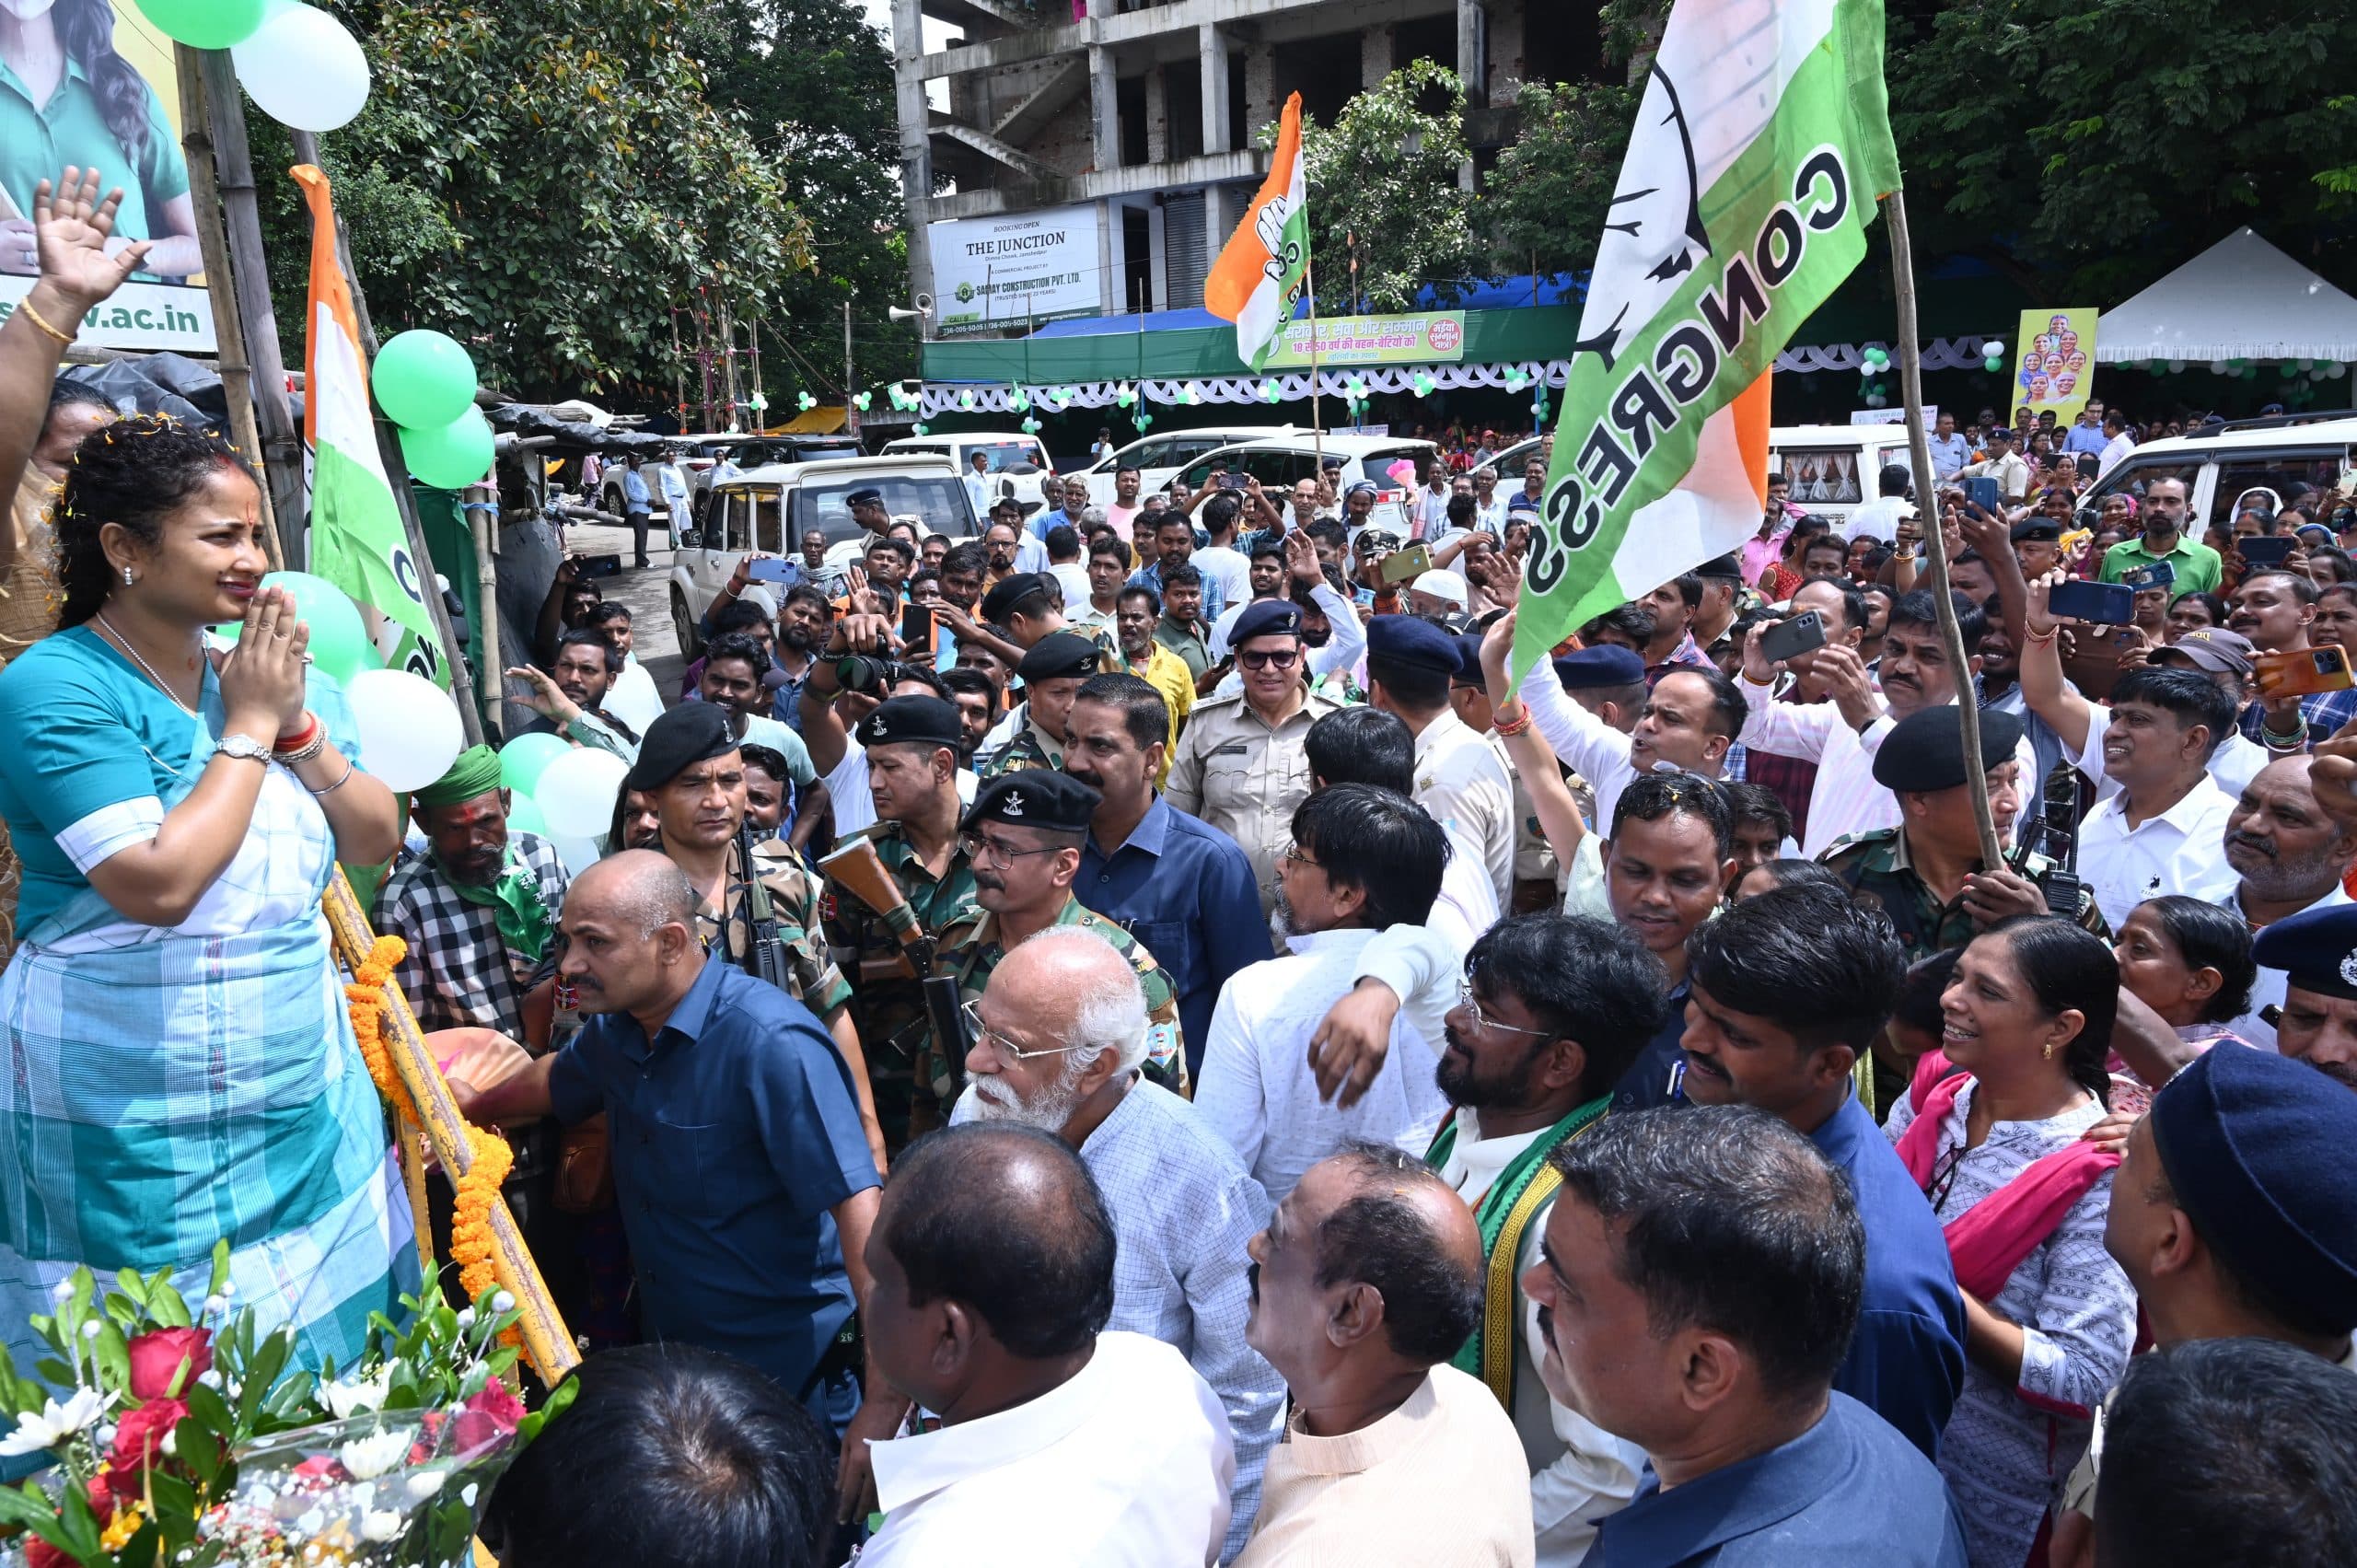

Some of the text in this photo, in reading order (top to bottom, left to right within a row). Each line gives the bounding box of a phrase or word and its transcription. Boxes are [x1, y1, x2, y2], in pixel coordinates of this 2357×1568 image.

[994, 221, 1040, 233] BOOKING OPEN
[966, 231, 1065, 256] THE JUNCTION
[1003, 277, 1050, 293] CONSTRUCTION
[1051, 274, 1065, 285] PVT.
[1067, 273, 1081, 284] LTD.
[1382, 318, 1428, 334] सम्मान
[1316, 342, 1326, 352] 50
